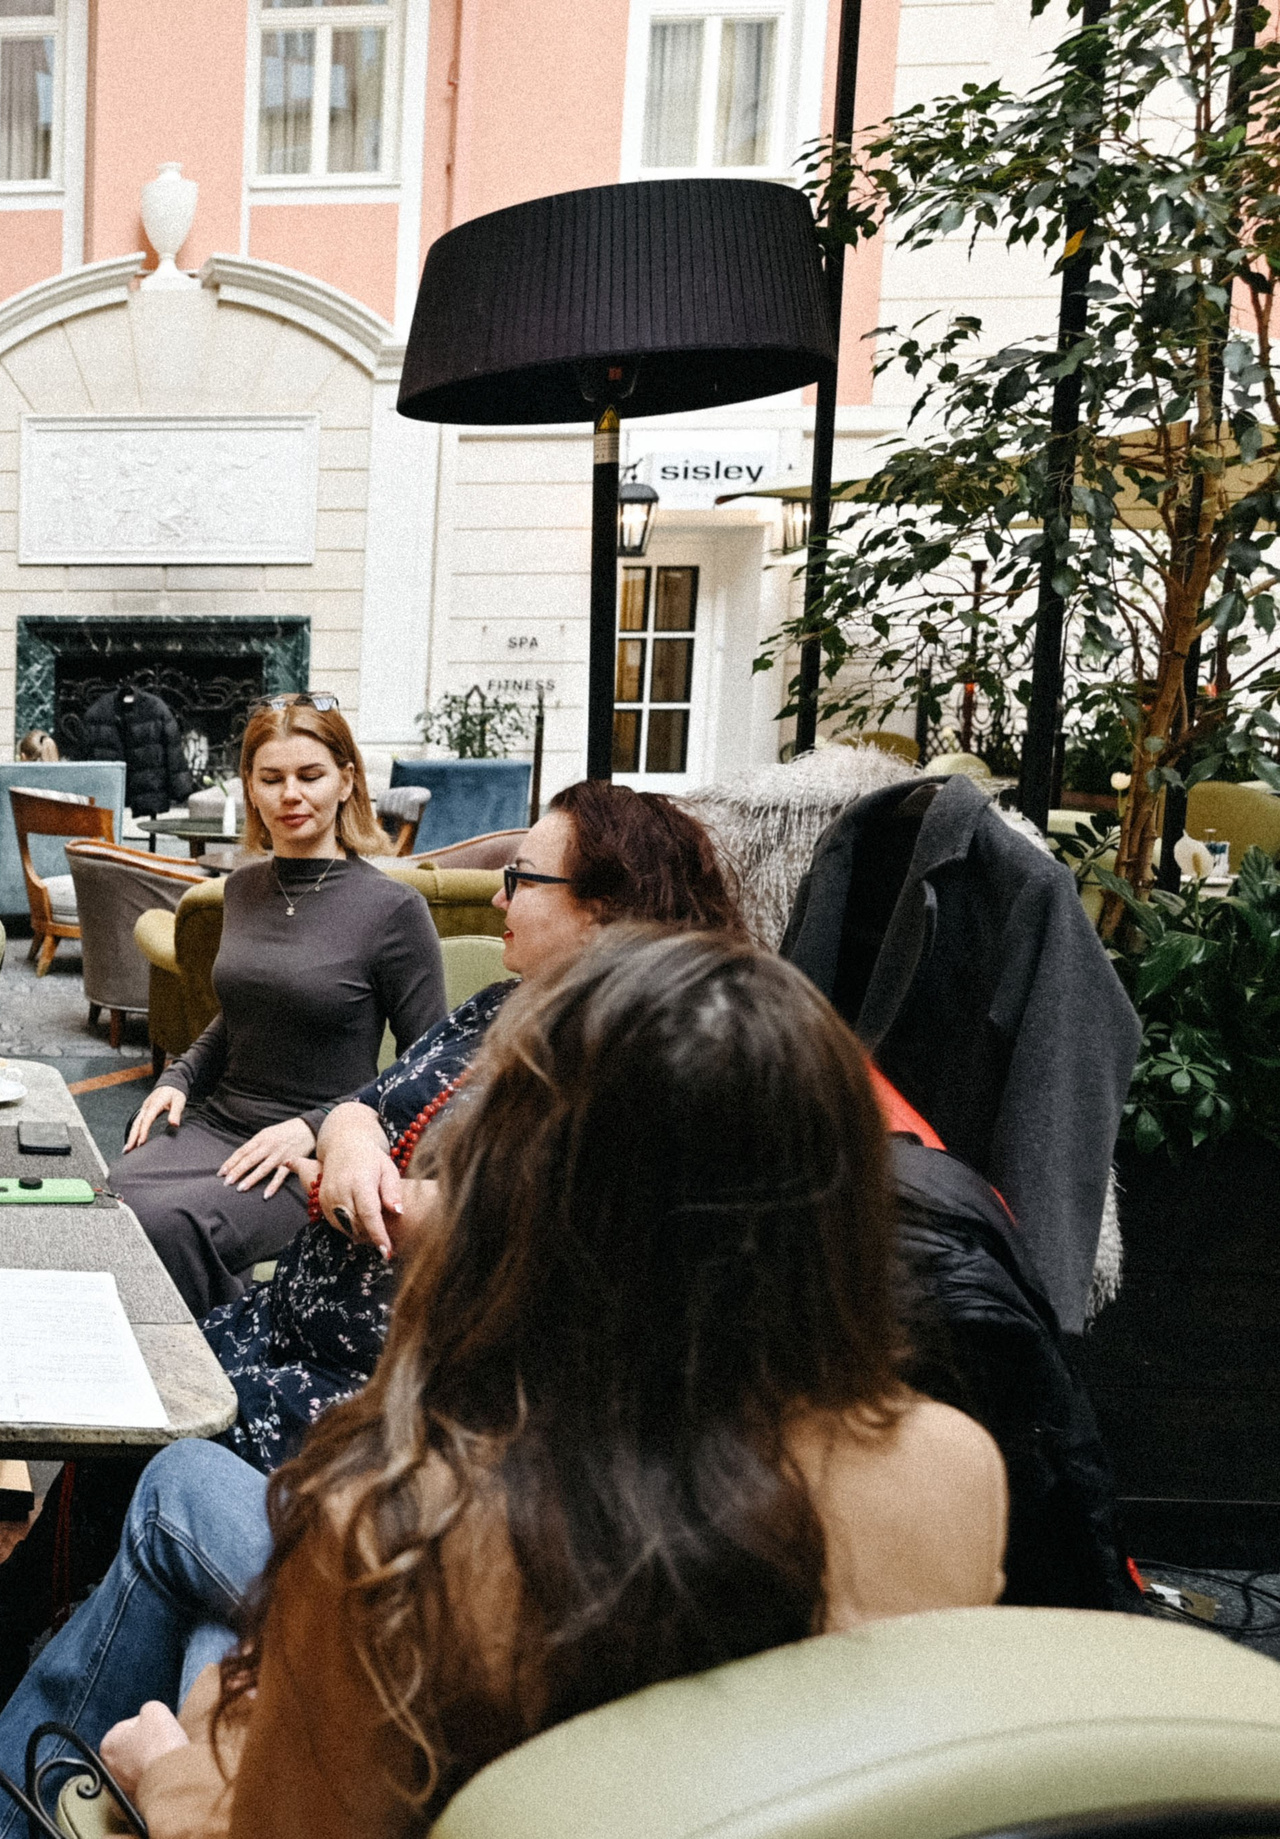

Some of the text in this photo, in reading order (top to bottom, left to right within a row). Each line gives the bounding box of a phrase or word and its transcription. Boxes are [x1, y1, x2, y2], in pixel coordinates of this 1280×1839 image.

[660, 459, 764, 484] sisley
[507, 636, 538, 648] SPA
[487, 679, 555, 691] FITNESS
